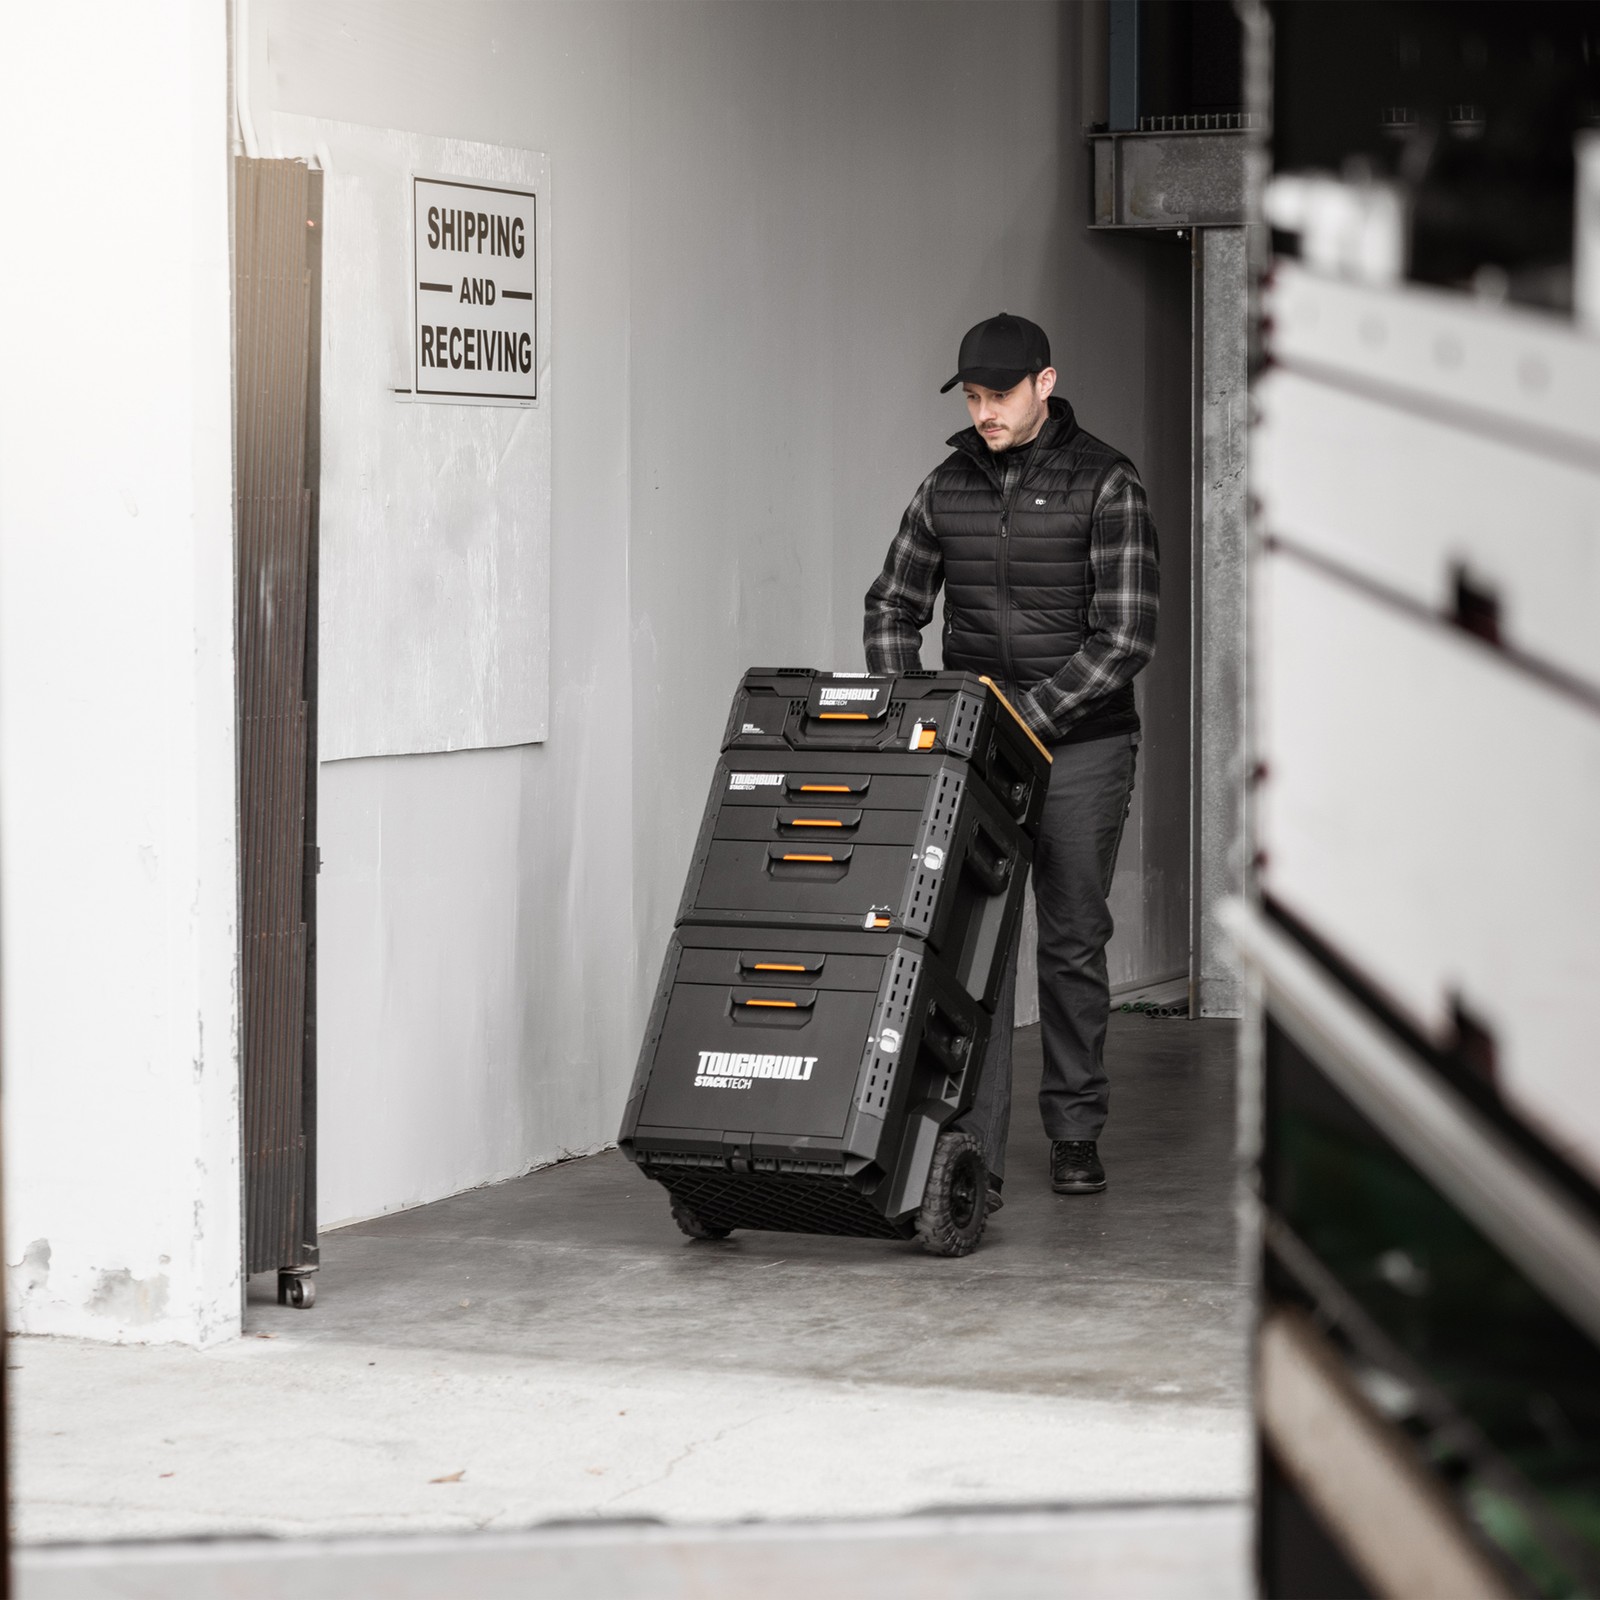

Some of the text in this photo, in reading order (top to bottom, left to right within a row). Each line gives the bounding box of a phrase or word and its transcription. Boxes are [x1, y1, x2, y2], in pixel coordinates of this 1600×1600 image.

[427, 206, 525, 259] SHIPPING
[459, 277, 496, 306] AND
[421, 324, 532, 374] RECEIVING
[820, 687, 880, 701] TOUGHBUILT
[730, 773, 785, 786] TOUGHBUILT
[696, 1051, 819, 1081] TOUGHBUILT
[693, 1075, 753, 1090] STACKTECH
